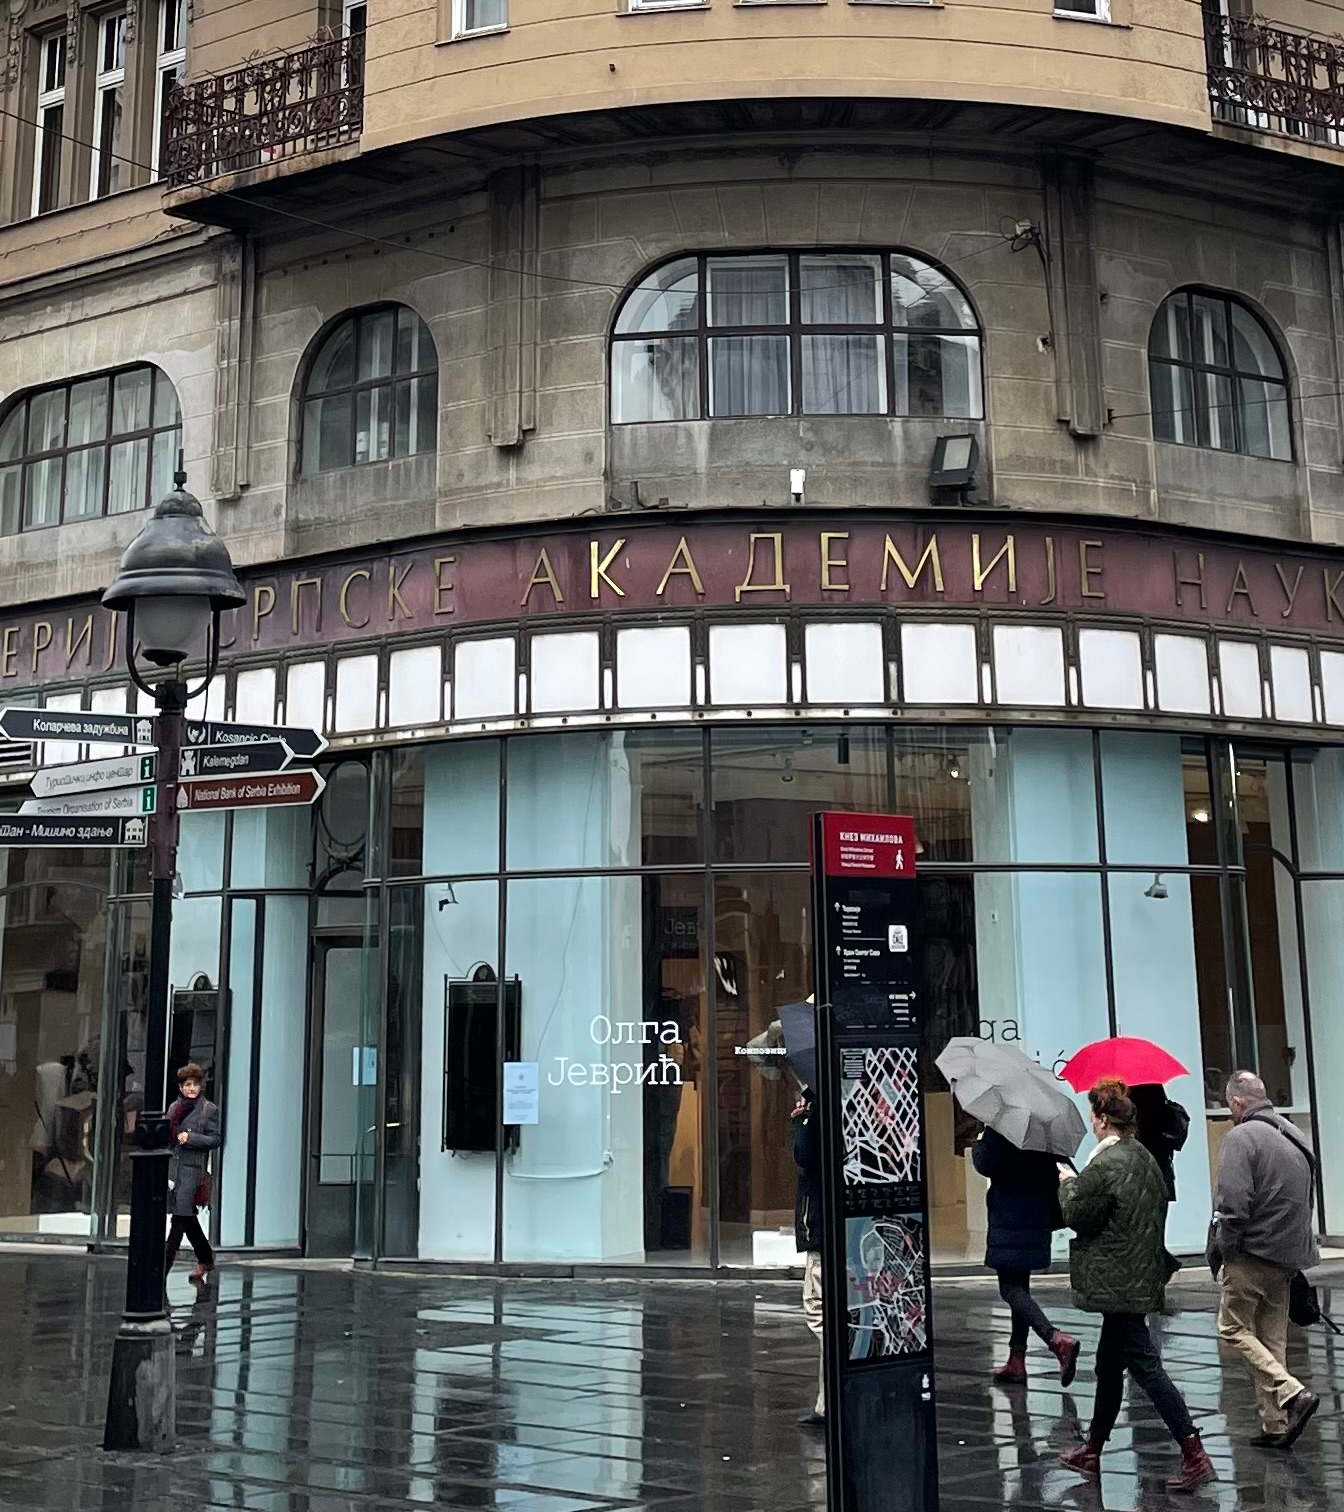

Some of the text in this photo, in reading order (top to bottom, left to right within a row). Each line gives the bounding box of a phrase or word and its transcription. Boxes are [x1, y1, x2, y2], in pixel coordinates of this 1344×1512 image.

[520, 531, 1106, 606] АКАДЕМИЈЕ
[33, 718, 129, 736] Коларчева задужбина
[202, 753, 249, 769] Kalemegdan
[194, 788, 220, 801] National
[220, 787, 237, 800] Bank
[245, 784, 267, 798] Serbia
[267, 783, 301, 797] Exhibition
[31, 824, 76, 837] Мишино
[77, 825, 114, 839] здање
[590, 1015, 682, 1045] Олга
[547, 1053, 684, 1094] Јеврић
